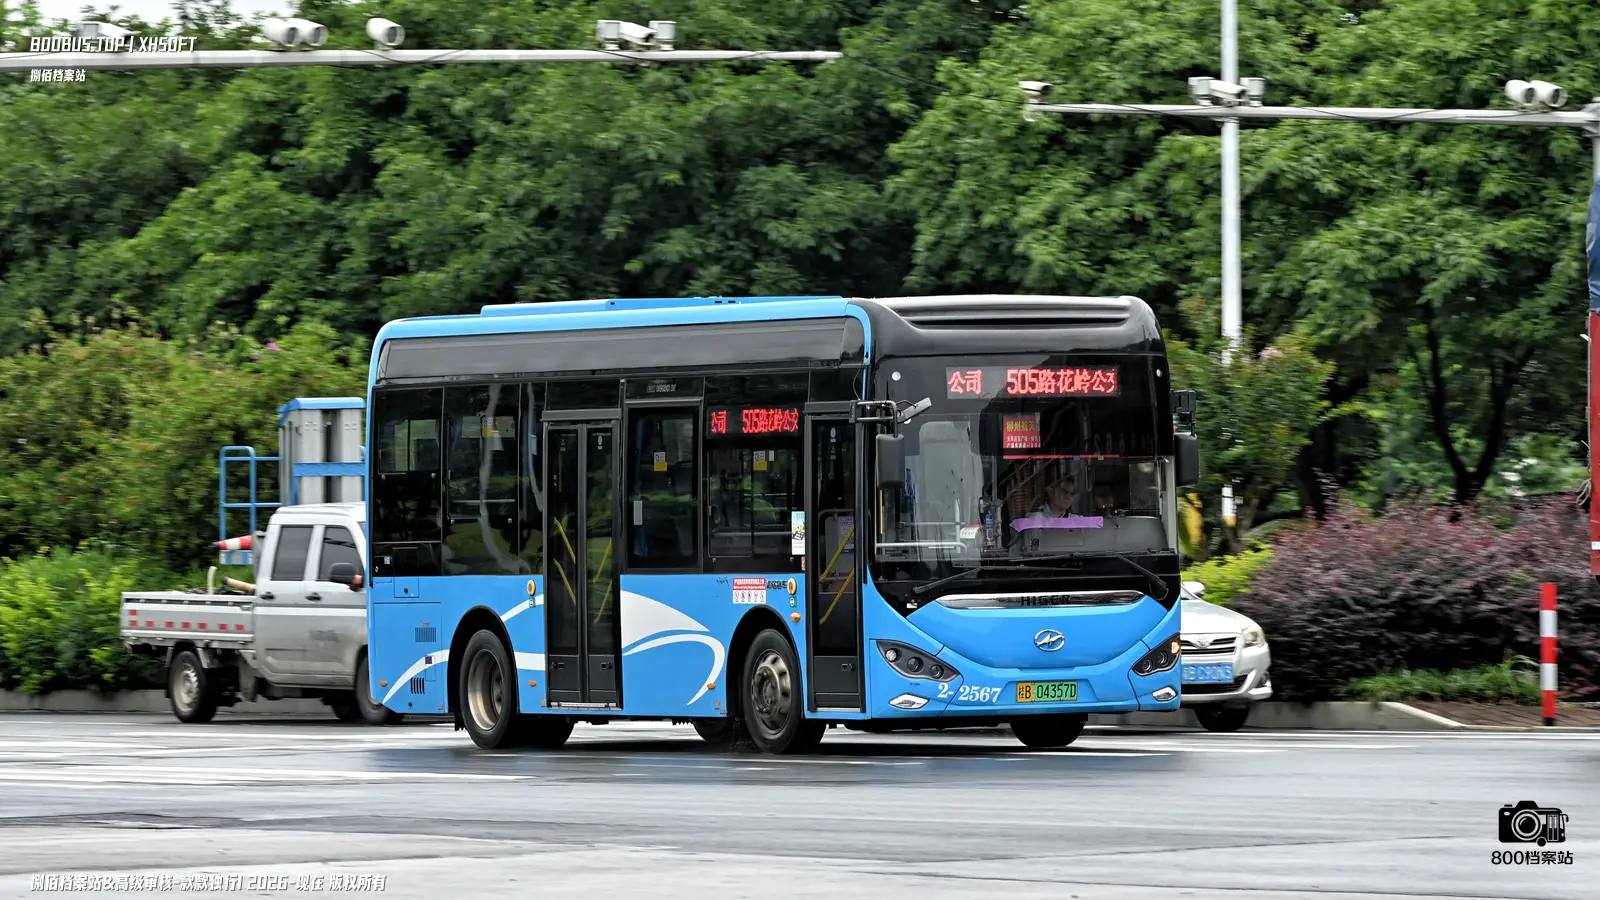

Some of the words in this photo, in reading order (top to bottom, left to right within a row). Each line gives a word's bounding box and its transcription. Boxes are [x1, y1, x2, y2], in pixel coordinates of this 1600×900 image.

[948, 369, 983, 395] 公司
[1020, 594, 1071, 606] HIGER
[1036, 683, 1077, 699] 04357D
